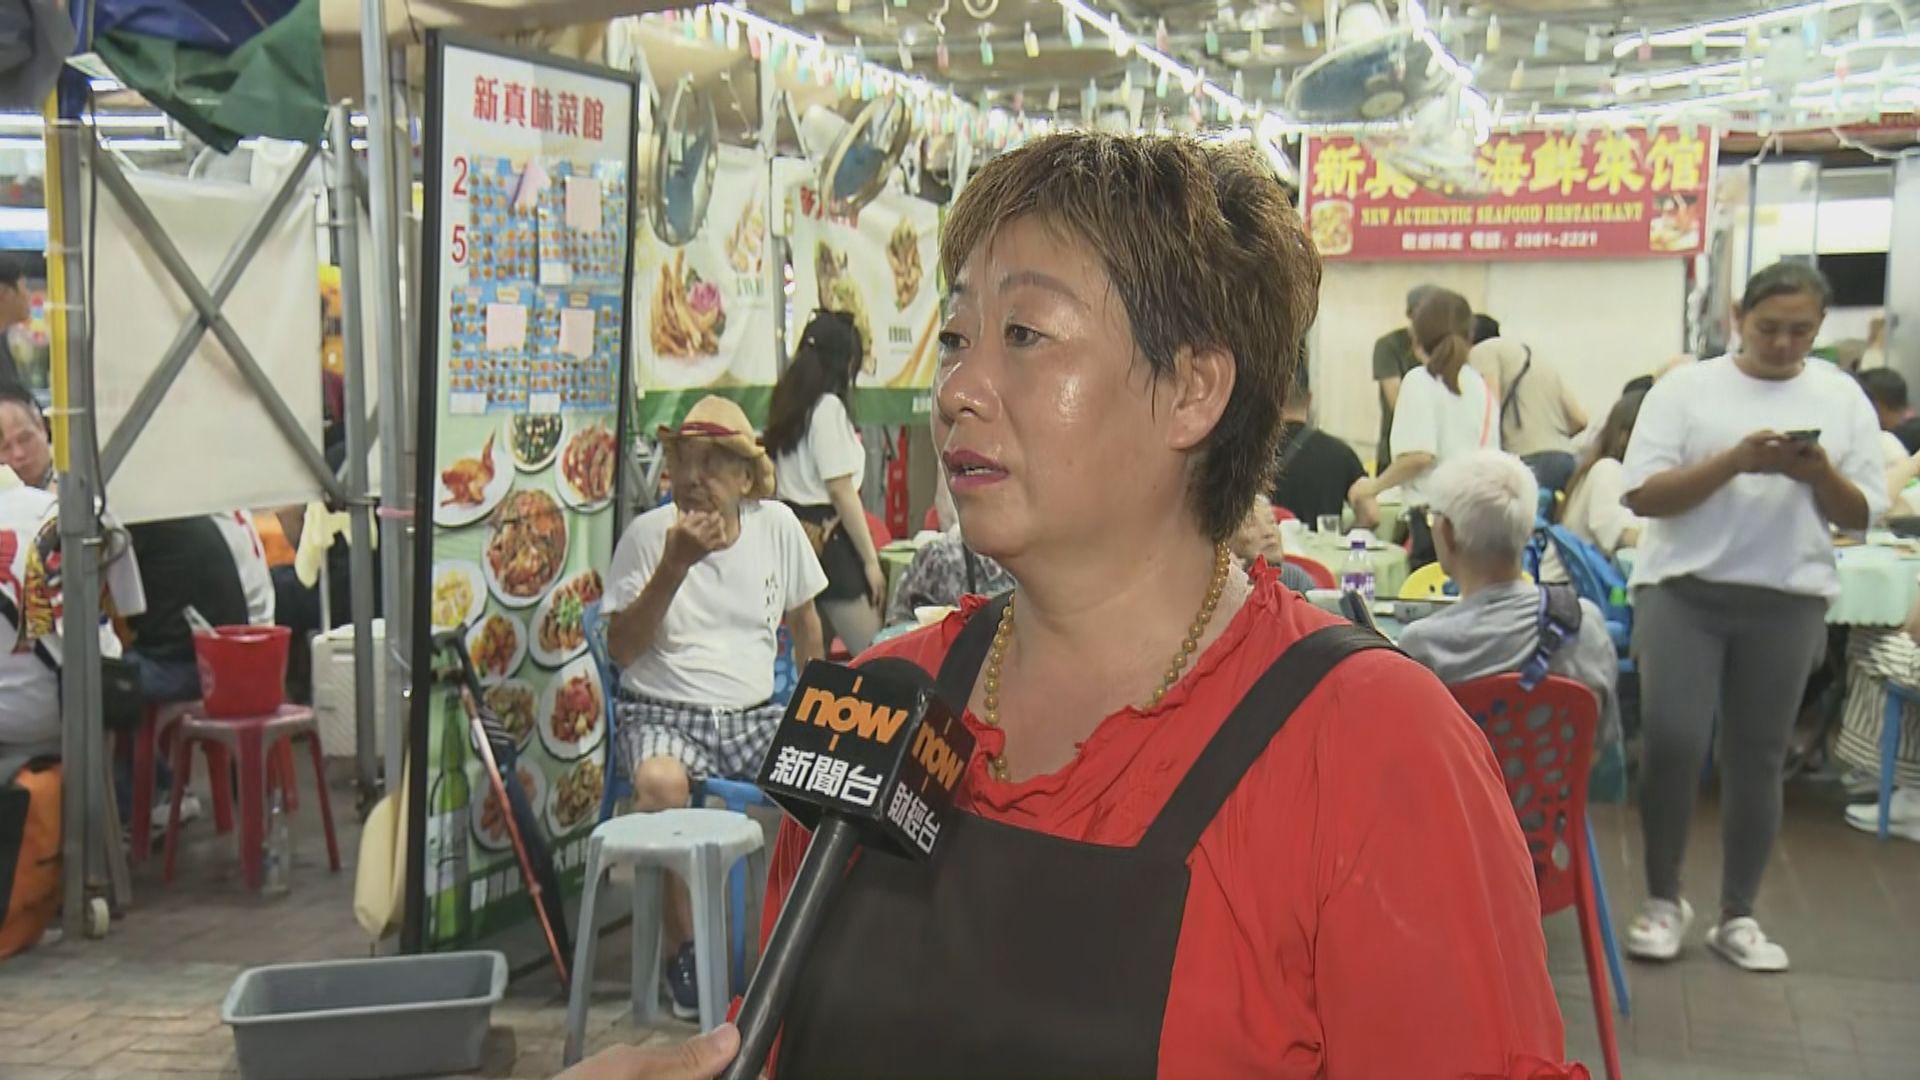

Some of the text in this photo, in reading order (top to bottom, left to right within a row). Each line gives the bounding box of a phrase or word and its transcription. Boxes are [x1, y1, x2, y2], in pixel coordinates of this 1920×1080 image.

[473, 75, 605, 142] 新真味菜館
[452, 156, 469, 197] 2
[451, 225, 468, 264] 5
[795, 686, 909, 745] now
[769, 746, 883, 807] 新聞台
[912, 719, 965, 792] now
[887, 782, 941, 854] 財經台
